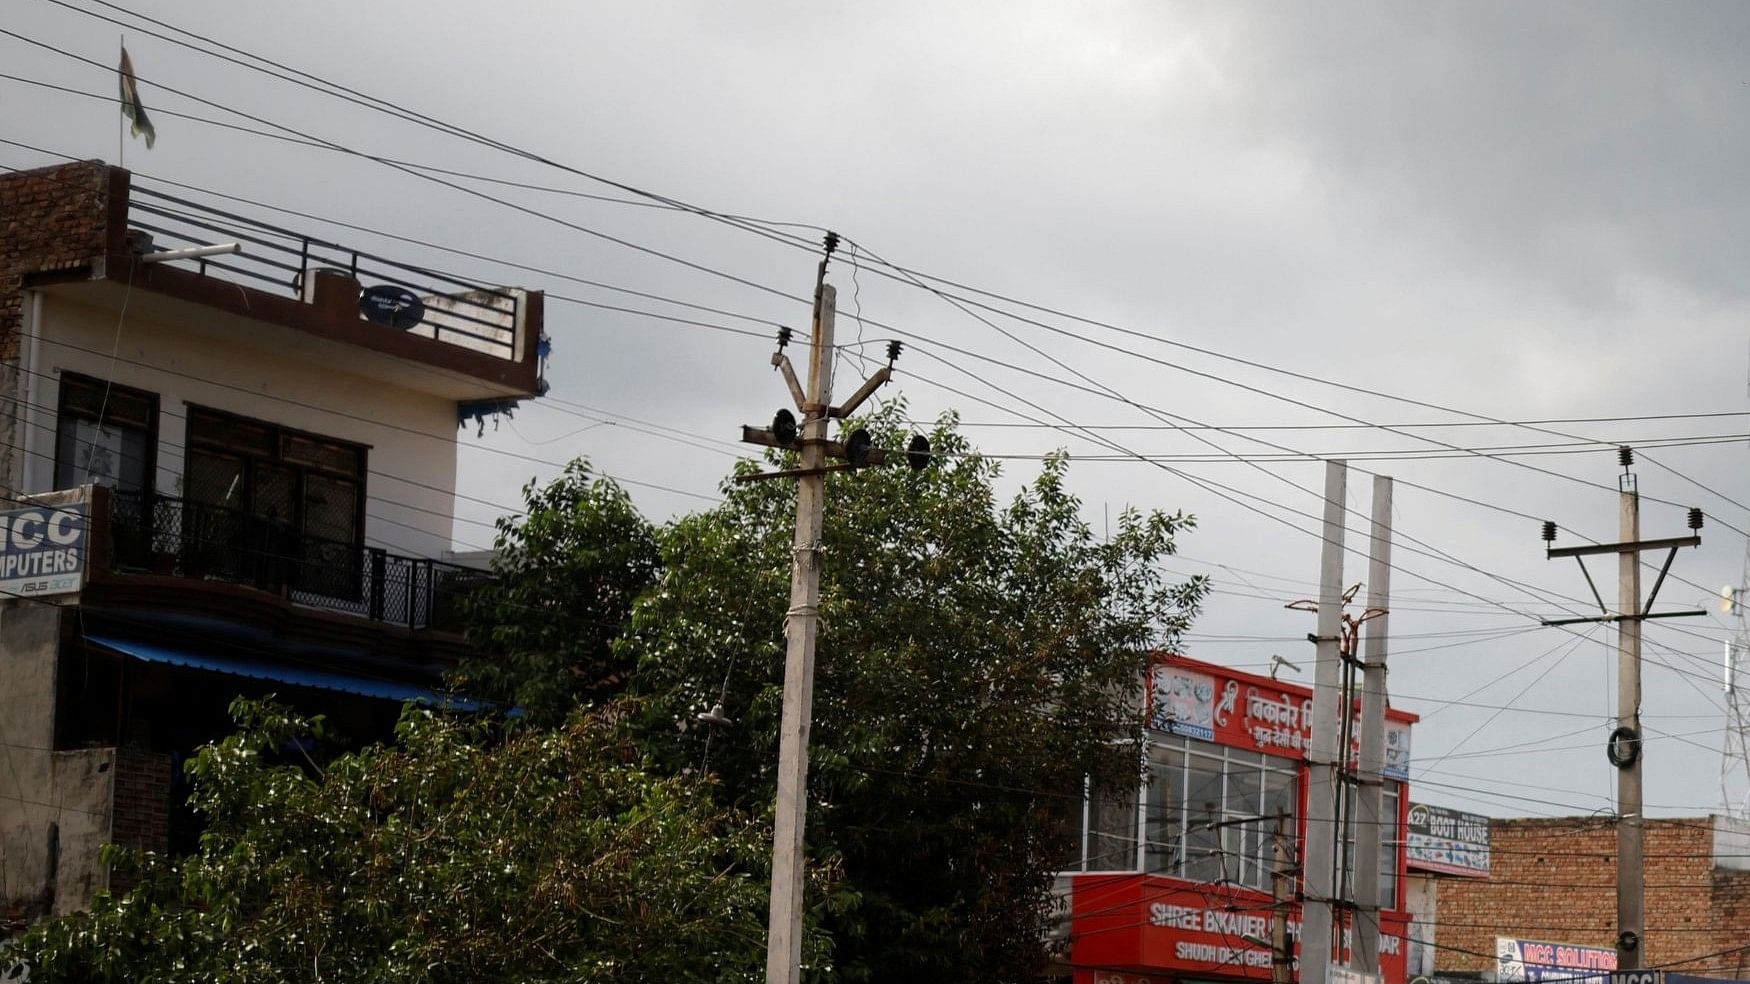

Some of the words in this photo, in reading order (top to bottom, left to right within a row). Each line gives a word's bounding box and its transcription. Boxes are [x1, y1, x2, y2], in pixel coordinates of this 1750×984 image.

[21, 582, 48, 592] ASUS
[1430, 814, 1456, 838] BOOT
[1457, 820, 1488, 845] HOUSE
[1150, 904, 1201, 930] SHREE
[1176, 942, 1216, 961] SHUDH
[1523, 943, 1554, 968] MCC
